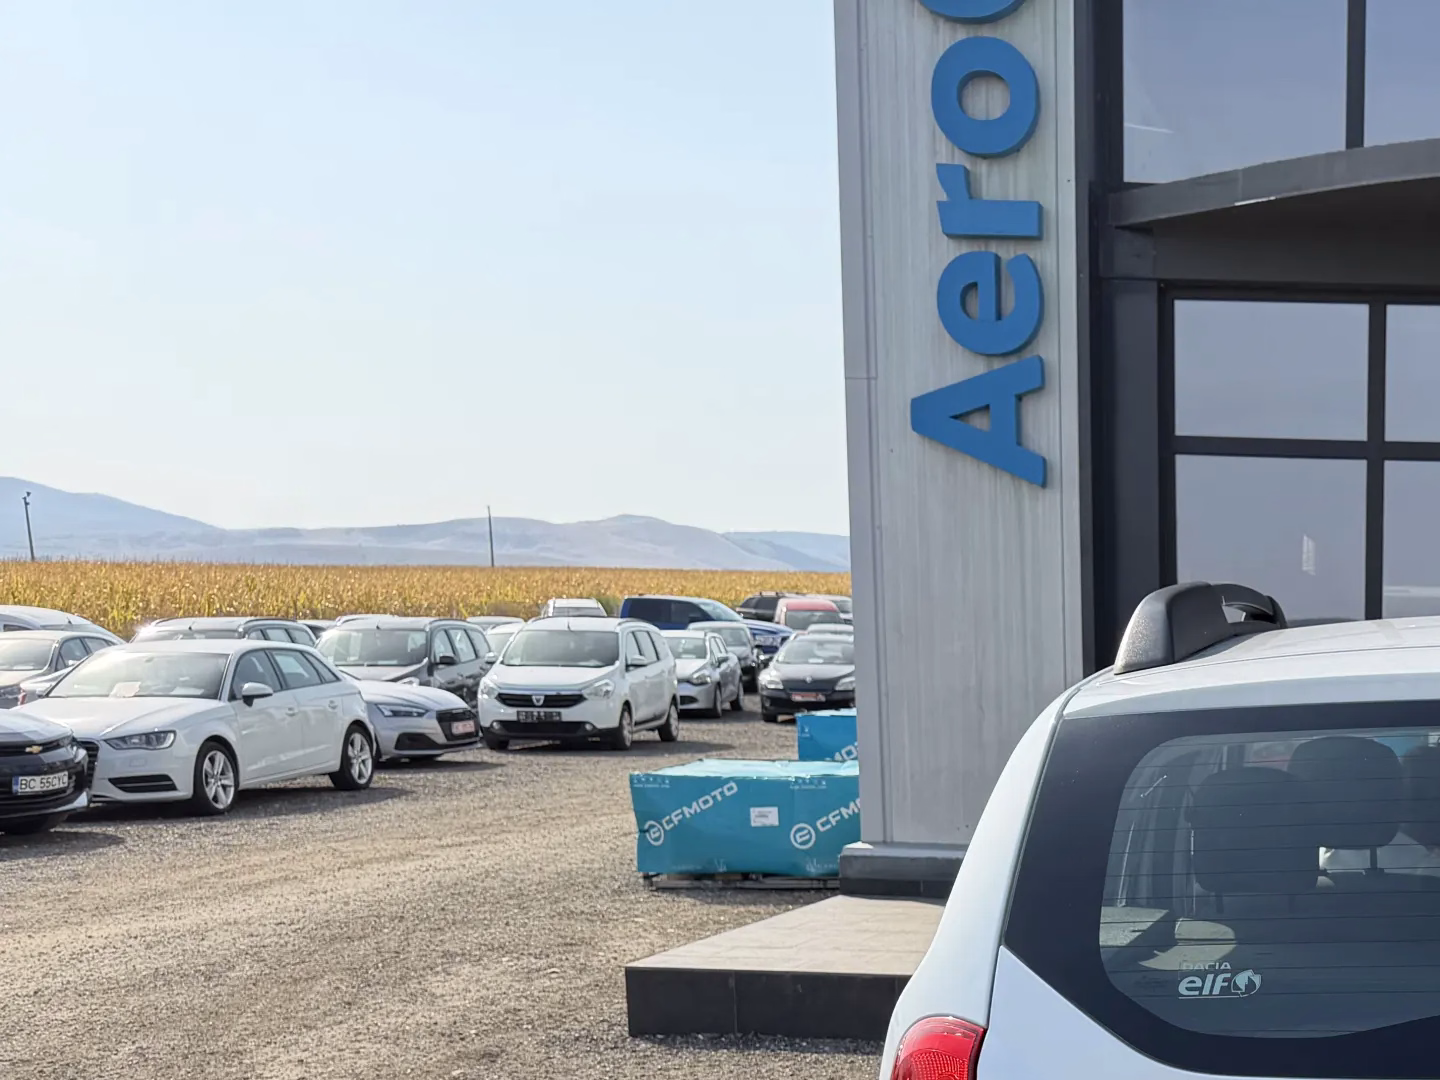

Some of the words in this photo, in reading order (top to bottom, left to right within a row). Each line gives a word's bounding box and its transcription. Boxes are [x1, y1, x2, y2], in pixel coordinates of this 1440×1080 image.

[911, 0, 1046, 488] Aero
[20, 778, 36, 790] BC
[661, 781, 739, 832] CFMOTO
[1182, 962, 1232, 970] DACIA
[1178, 972, 1231, 996] elf
